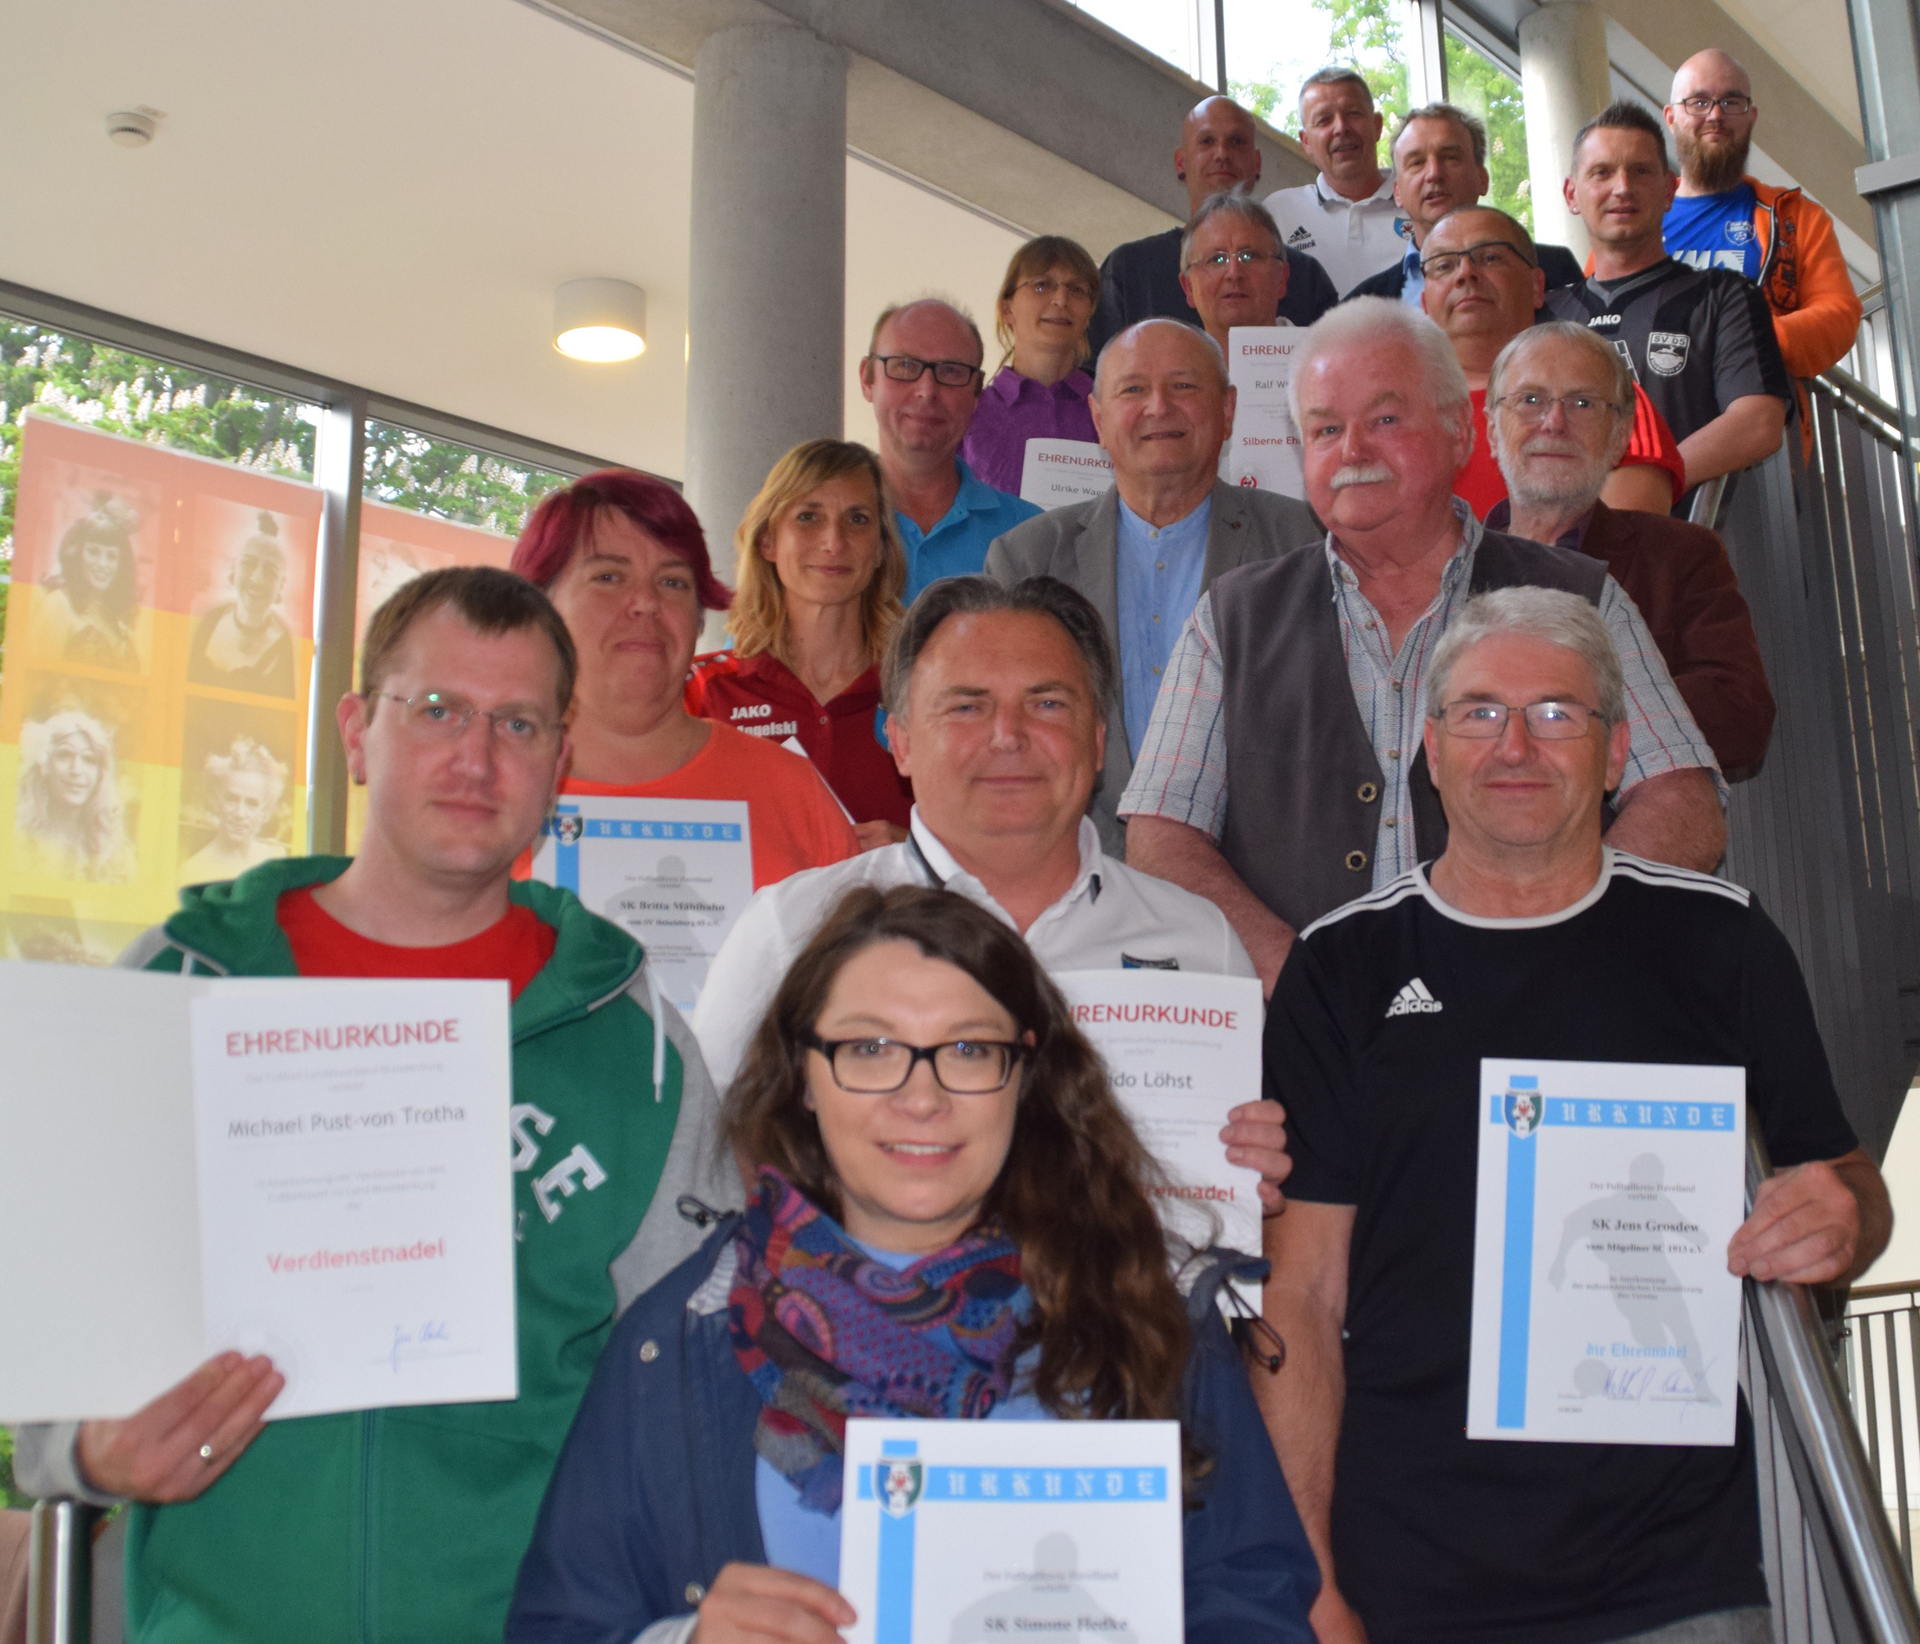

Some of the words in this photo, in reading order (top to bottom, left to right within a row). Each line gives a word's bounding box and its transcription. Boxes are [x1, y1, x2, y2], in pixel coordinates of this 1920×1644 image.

[1587, 314, 1622, 327] JAKO
[1654, 335, 1669, 343] SV
[1672, 337, 1686, 346] 05
[1242, 345, 1295, 356] EHRENU
[1255, 380, 1274, 389] Ralf
[1276, 380, 1289, 389] W
[1242, 436, 1283, 446] Silberne
[1286, 436, 1301, 445] Eh
[1051, 484, 1079, 494] Ulrike
[730, 704, 772, 720] JAKO
[599, 822, 734, 839] URKUNDE
[619, 900, 636, 910] SK
[639, 900, 669, 910] Britta
[1069, 1004, 1238, 1030] RENURKUNDE
[1385, 999, 1443, 1019] adidas
[225, 1018, 460, 1057] EHRENURKUNDE
[1143, 1070, 1194, 1089] Löhst
[227, 1115, 304, 1138] Michael
[310, 1111, 394, 1132] Pust-von
[401, 1103, 466, 1124] Trotha
[1562, 1102, 1726, 1127] URKUNDE
[1136, 1185, 1235, 1202] rennadel
[1591, 1218, 1611, 1231] SK
[1614, 1219, 1642, 1231] Jens
[1645, 1220, 1700, 1233] Grosdew
[266, 1236, 445, 1274] Verdienstnadel
[1668, 1245, 1688, 1253] 1913
[1586, 1342, 1606, 1357] die
[1611, 1342, 1688, 1359] Ehrennadel
[948, 1471, 1156, 1498] URKUNDE
